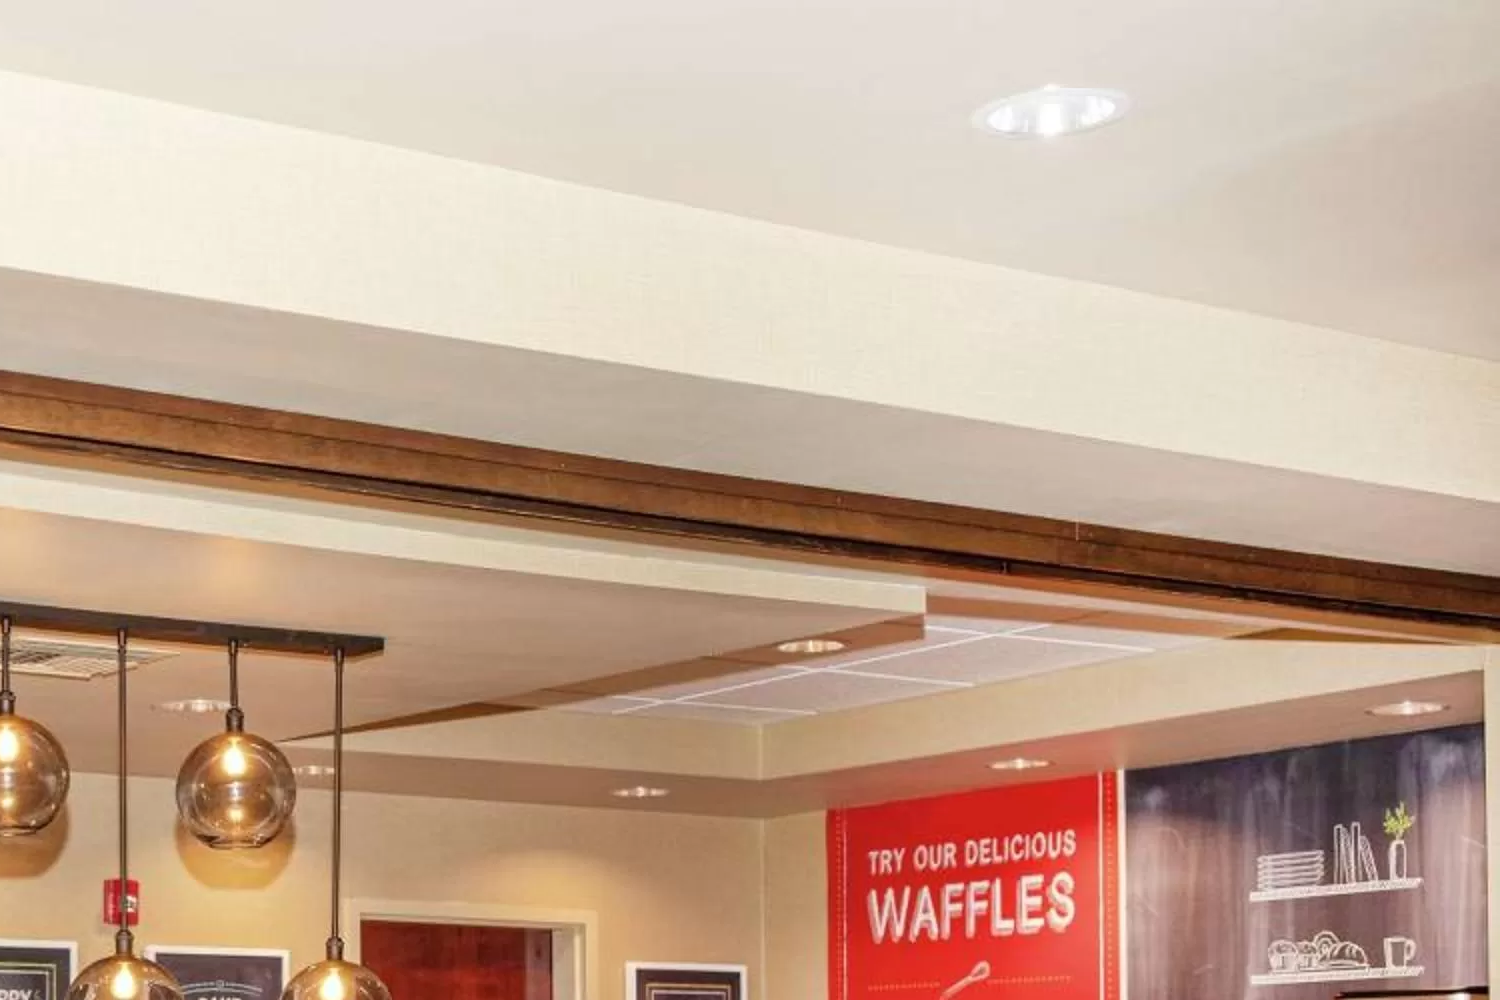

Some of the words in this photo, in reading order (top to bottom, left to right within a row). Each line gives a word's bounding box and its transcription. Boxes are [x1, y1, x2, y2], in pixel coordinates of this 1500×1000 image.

[868, 848, 905, 875] TRY
[913, 843, 957, 871] OUR
[965, 829, 1077, 866] DELICIOUS
[867, 871, 1076, 944] WAFFLES
